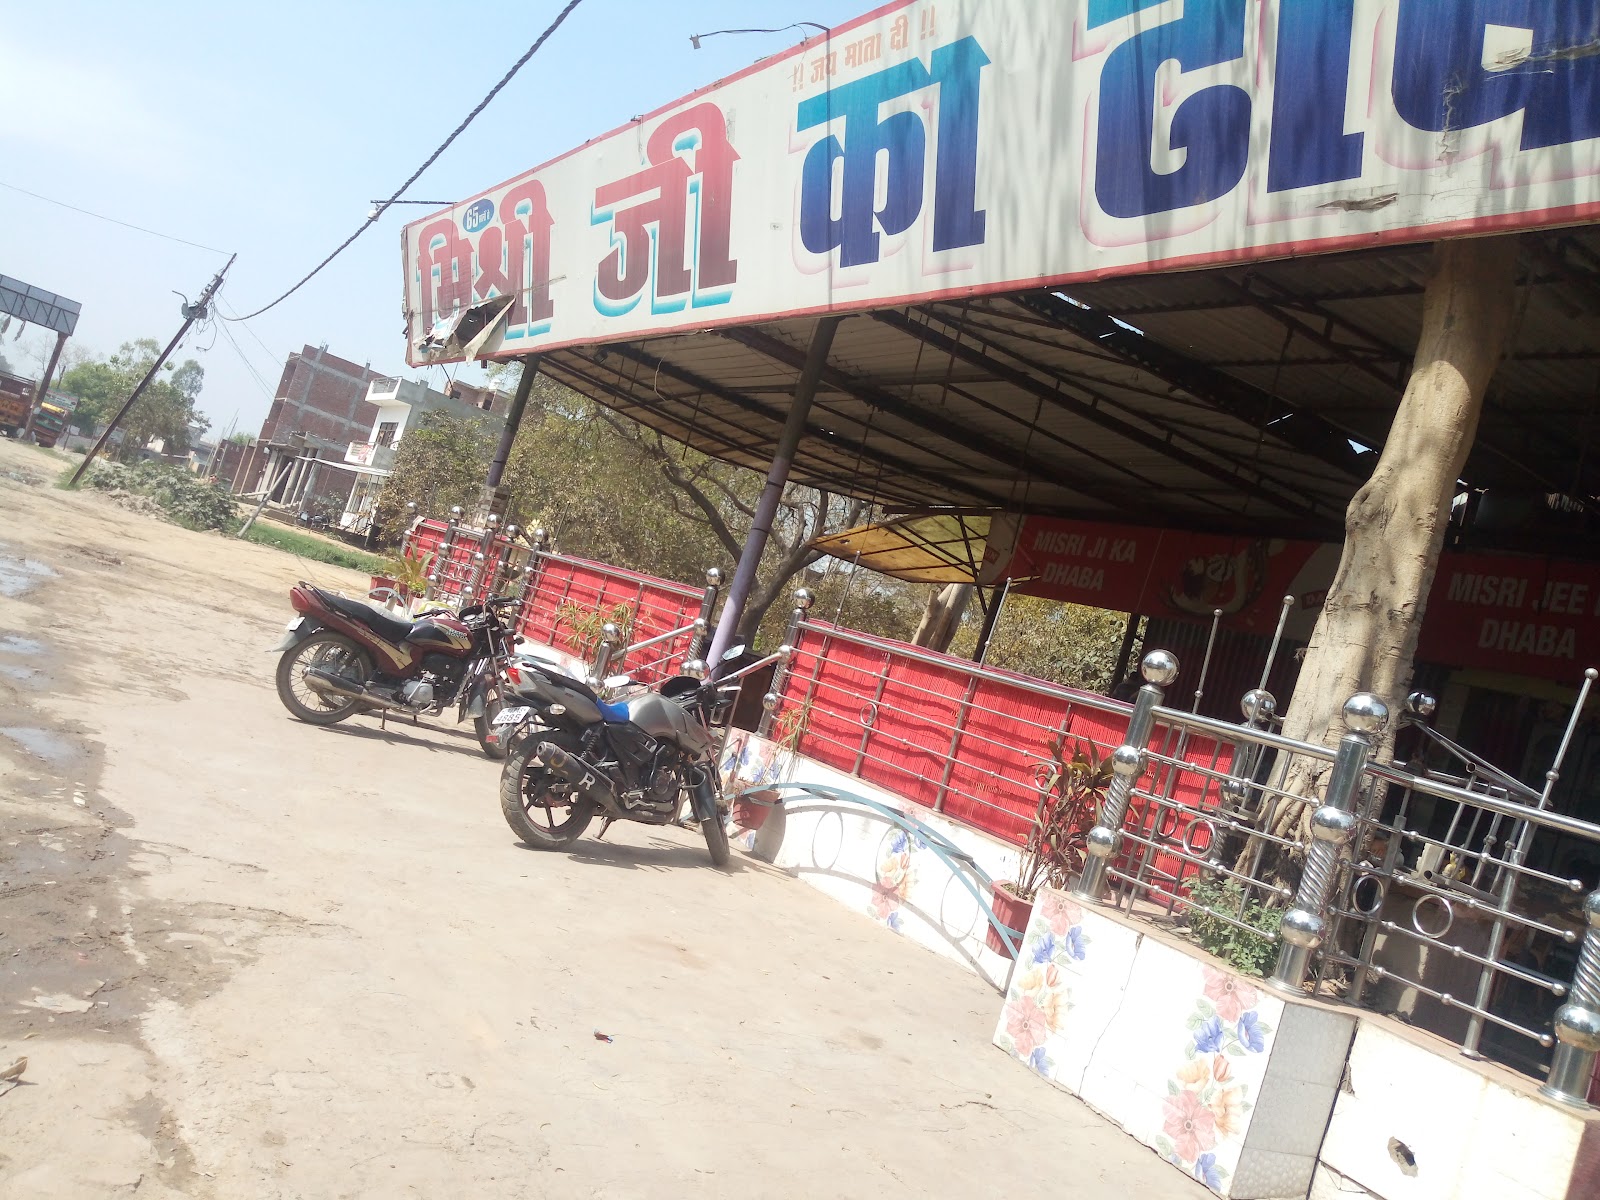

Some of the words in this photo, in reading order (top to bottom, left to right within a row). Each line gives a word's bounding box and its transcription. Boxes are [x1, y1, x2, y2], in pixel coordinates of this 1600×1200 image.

[810, 51, 838, 84] जय
[844, 32, 882, 68] माता
[890, 14, 909, 51] दी
[417, 178, 556, 338] मिश्री
[594, 101, 742, 305] जी
[797, 35, 991, 268] का
[466, 206, 479, 230] 65
[1032, 530, 1087, 557] MISRI
[1086, 538, 1108, 559] JI
[1108, 540, 1137, 564] KA
[1041, 562, 1105, 592] DHABA
[1448, 572, 1528, 608] MISRI
[1531, 580, 1589, 615] JEE
[1477, 618, 1576, 659] DHABA
